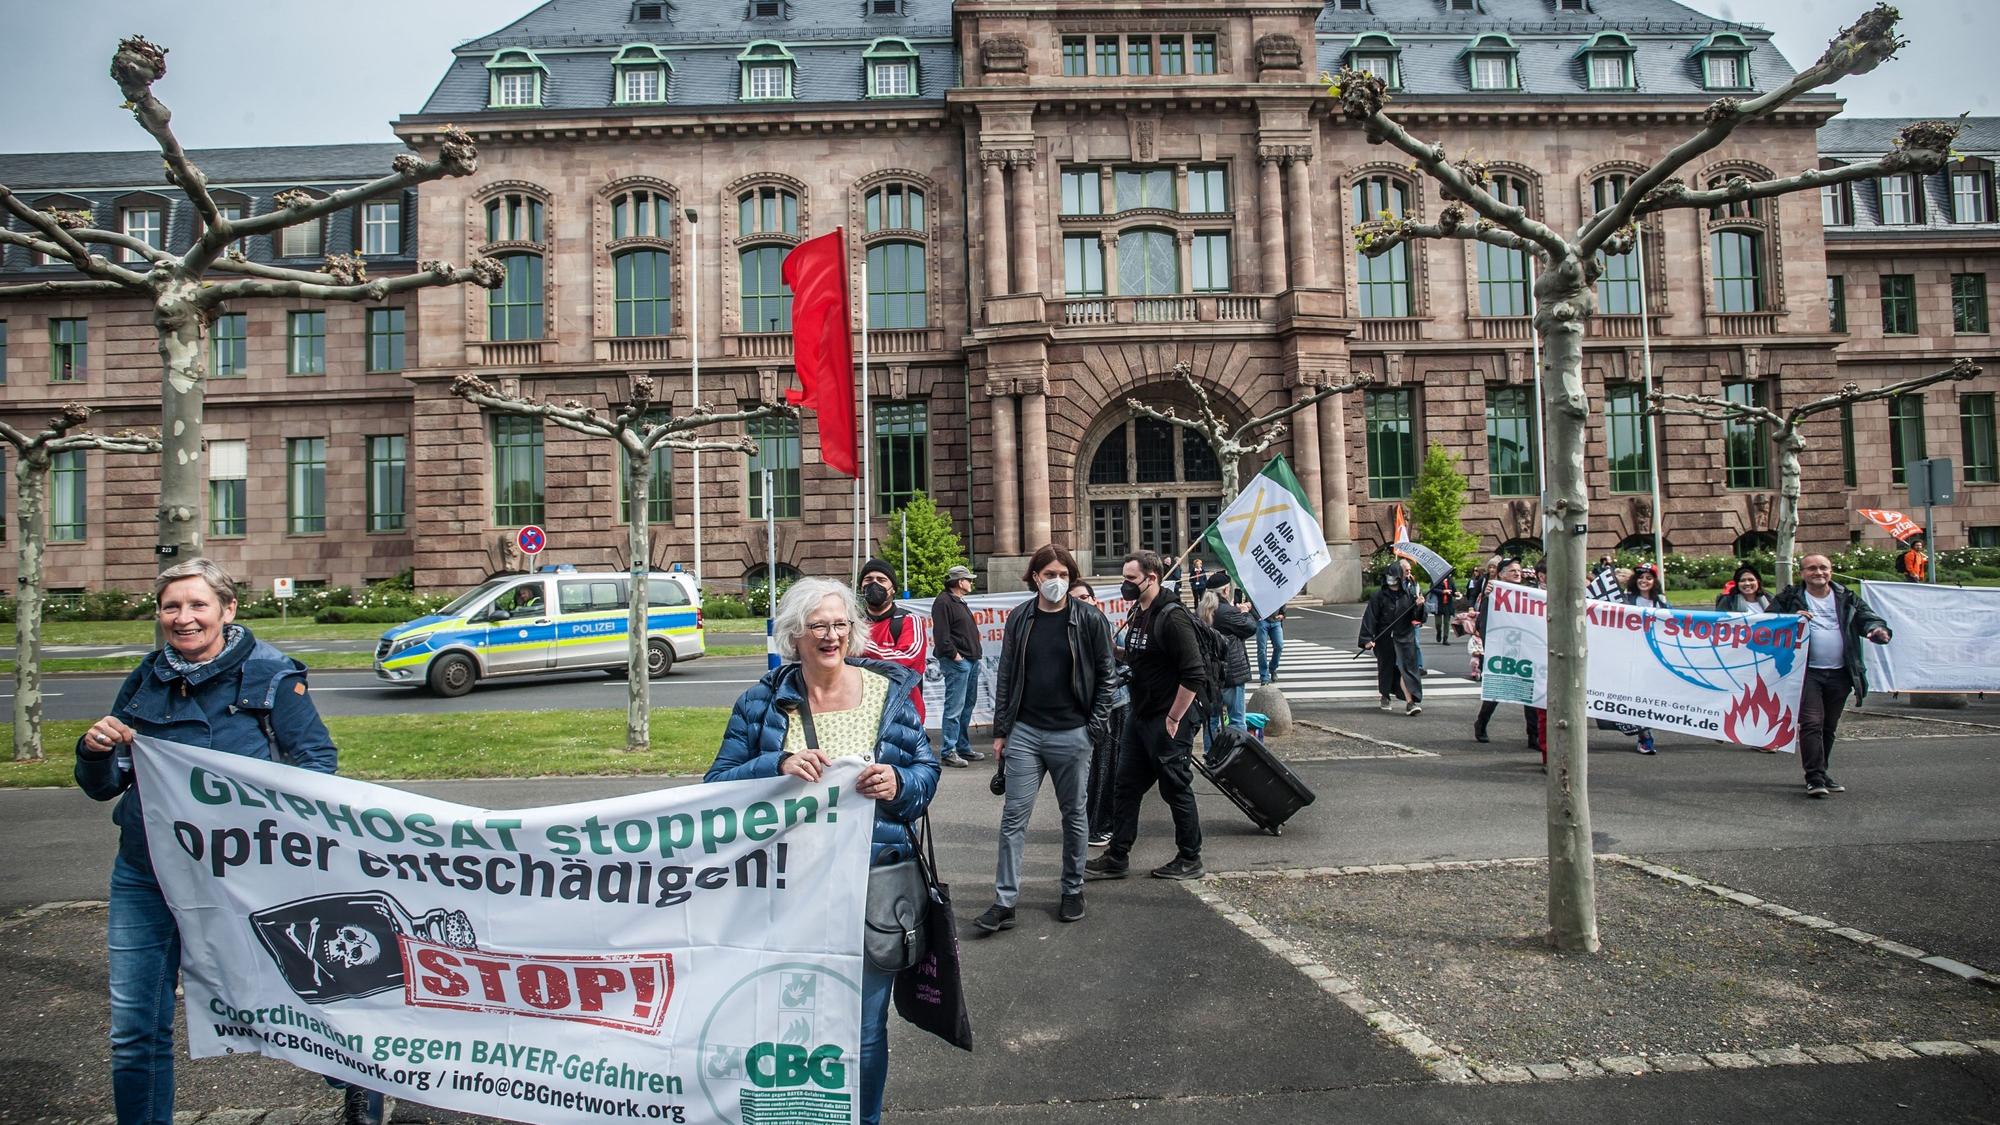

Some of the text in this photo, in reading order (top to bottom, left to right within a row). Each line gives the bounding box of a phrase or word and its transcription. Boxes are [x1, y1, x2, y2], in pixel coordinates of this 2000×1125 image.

[1263, 532, 1291, 566] Dörfer
[1275, 521, 1295, 544] Alle
[1250, 544, 1289, 589] BLEIBEN!
[572, 621, 615, 634] POLIZEI
[1494, 587, 1548, 617] Klim
[1664, 614, 1806, 650] stoppen!
[1487, 655, 1533, 678] CBG
[1606, 692, 1633, 702] gegen
[1635, 695, 1720, 717] BAYER-Gefahren
[189, 766, 841, 859] GLYPHOSAT stoppen!
[173, 819, 788, 908] Opfer entschädigen!
[416, 948, 655, 1019] STOP!
[209, 997, 684, 1095] Coordination gegen BAYER-Gefahren
[744, 1041, 846, 1090] CBG
[436, 1070, 446, 1088] /
[452, 1070, 686, 1124] info@CBGnetwork.org
